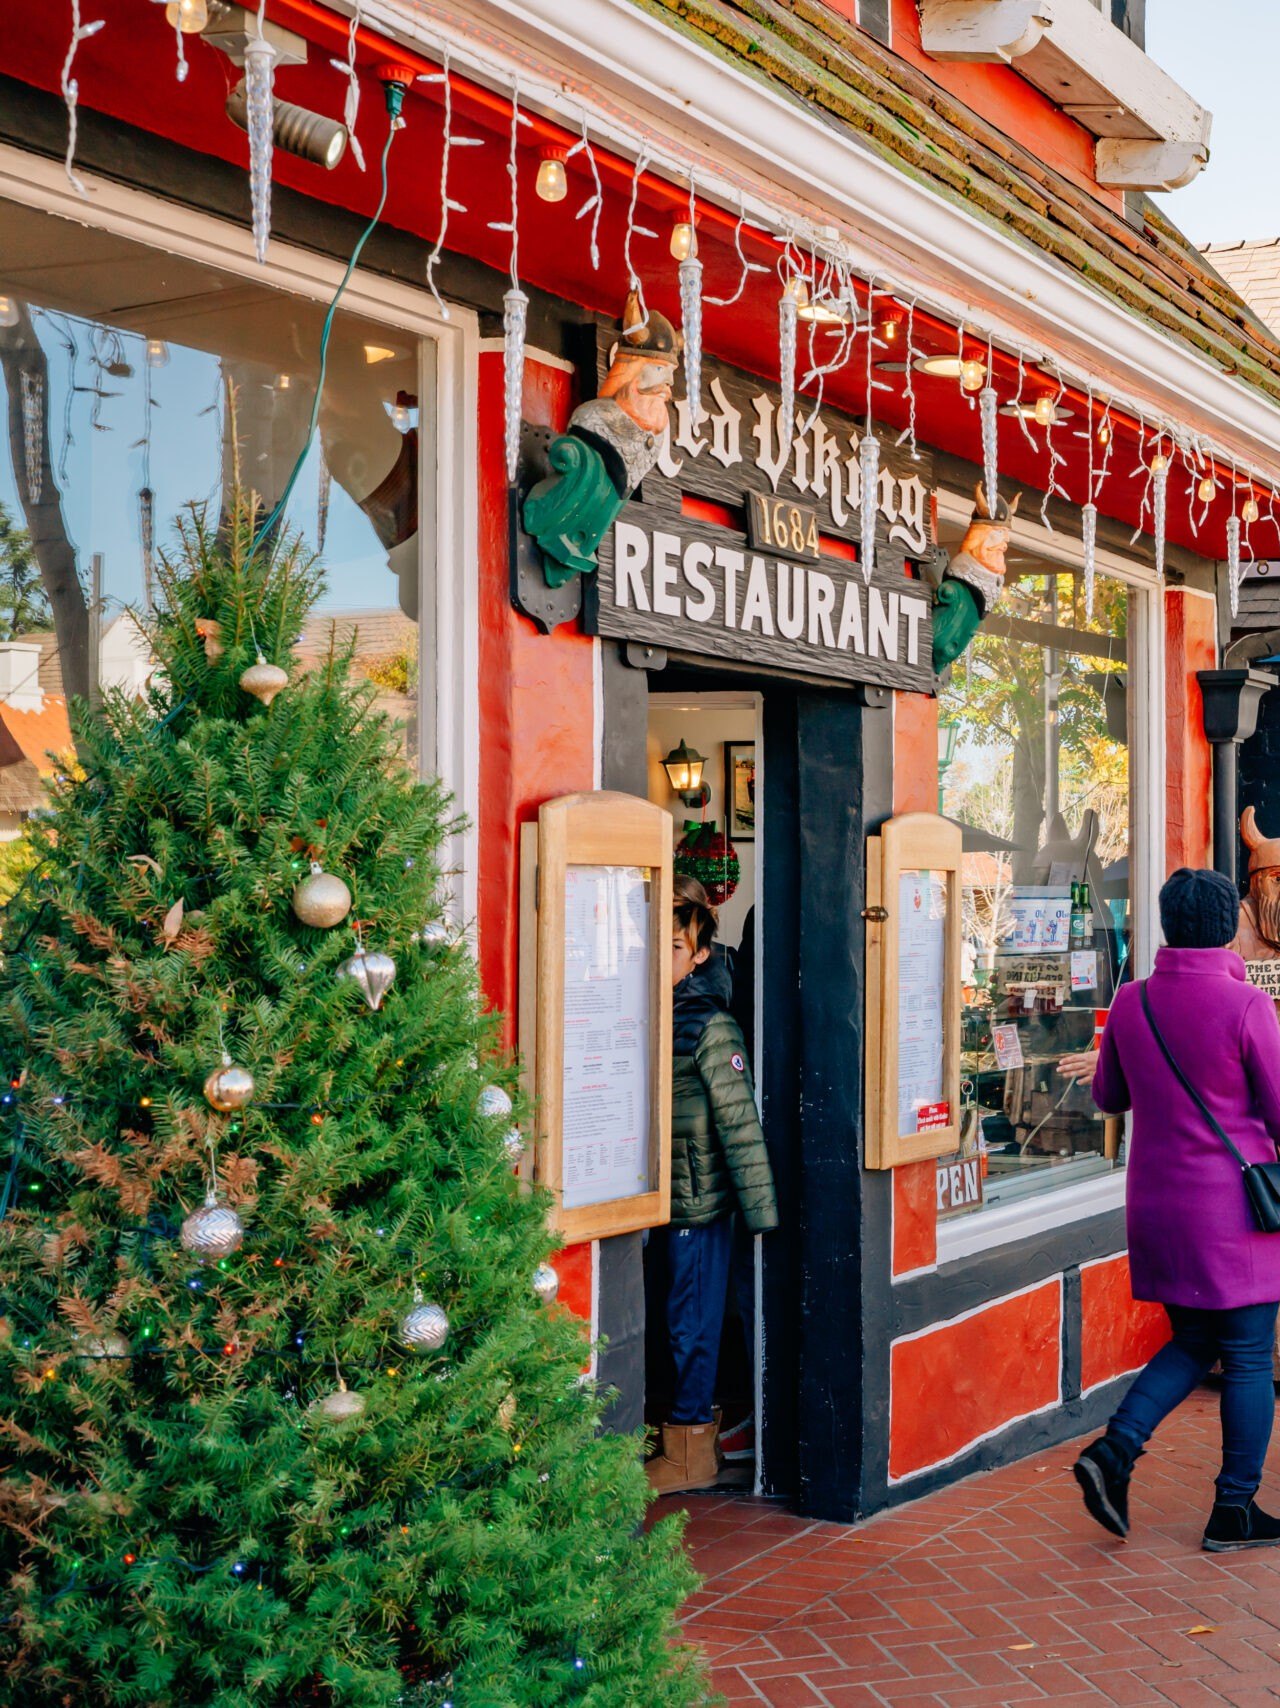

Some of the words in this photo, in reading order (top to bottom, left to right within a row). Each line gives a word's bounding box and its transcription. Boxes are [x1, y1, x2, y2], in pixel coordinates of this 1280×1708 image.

[753, 392, 927, 554] Viking
[757, 494, 820, 559] 1684
[614, 520, 927, 666] RESTAURANT
[1245, 964, 1272, 974] THE
[936, 1160, 979, 1210] PEN
